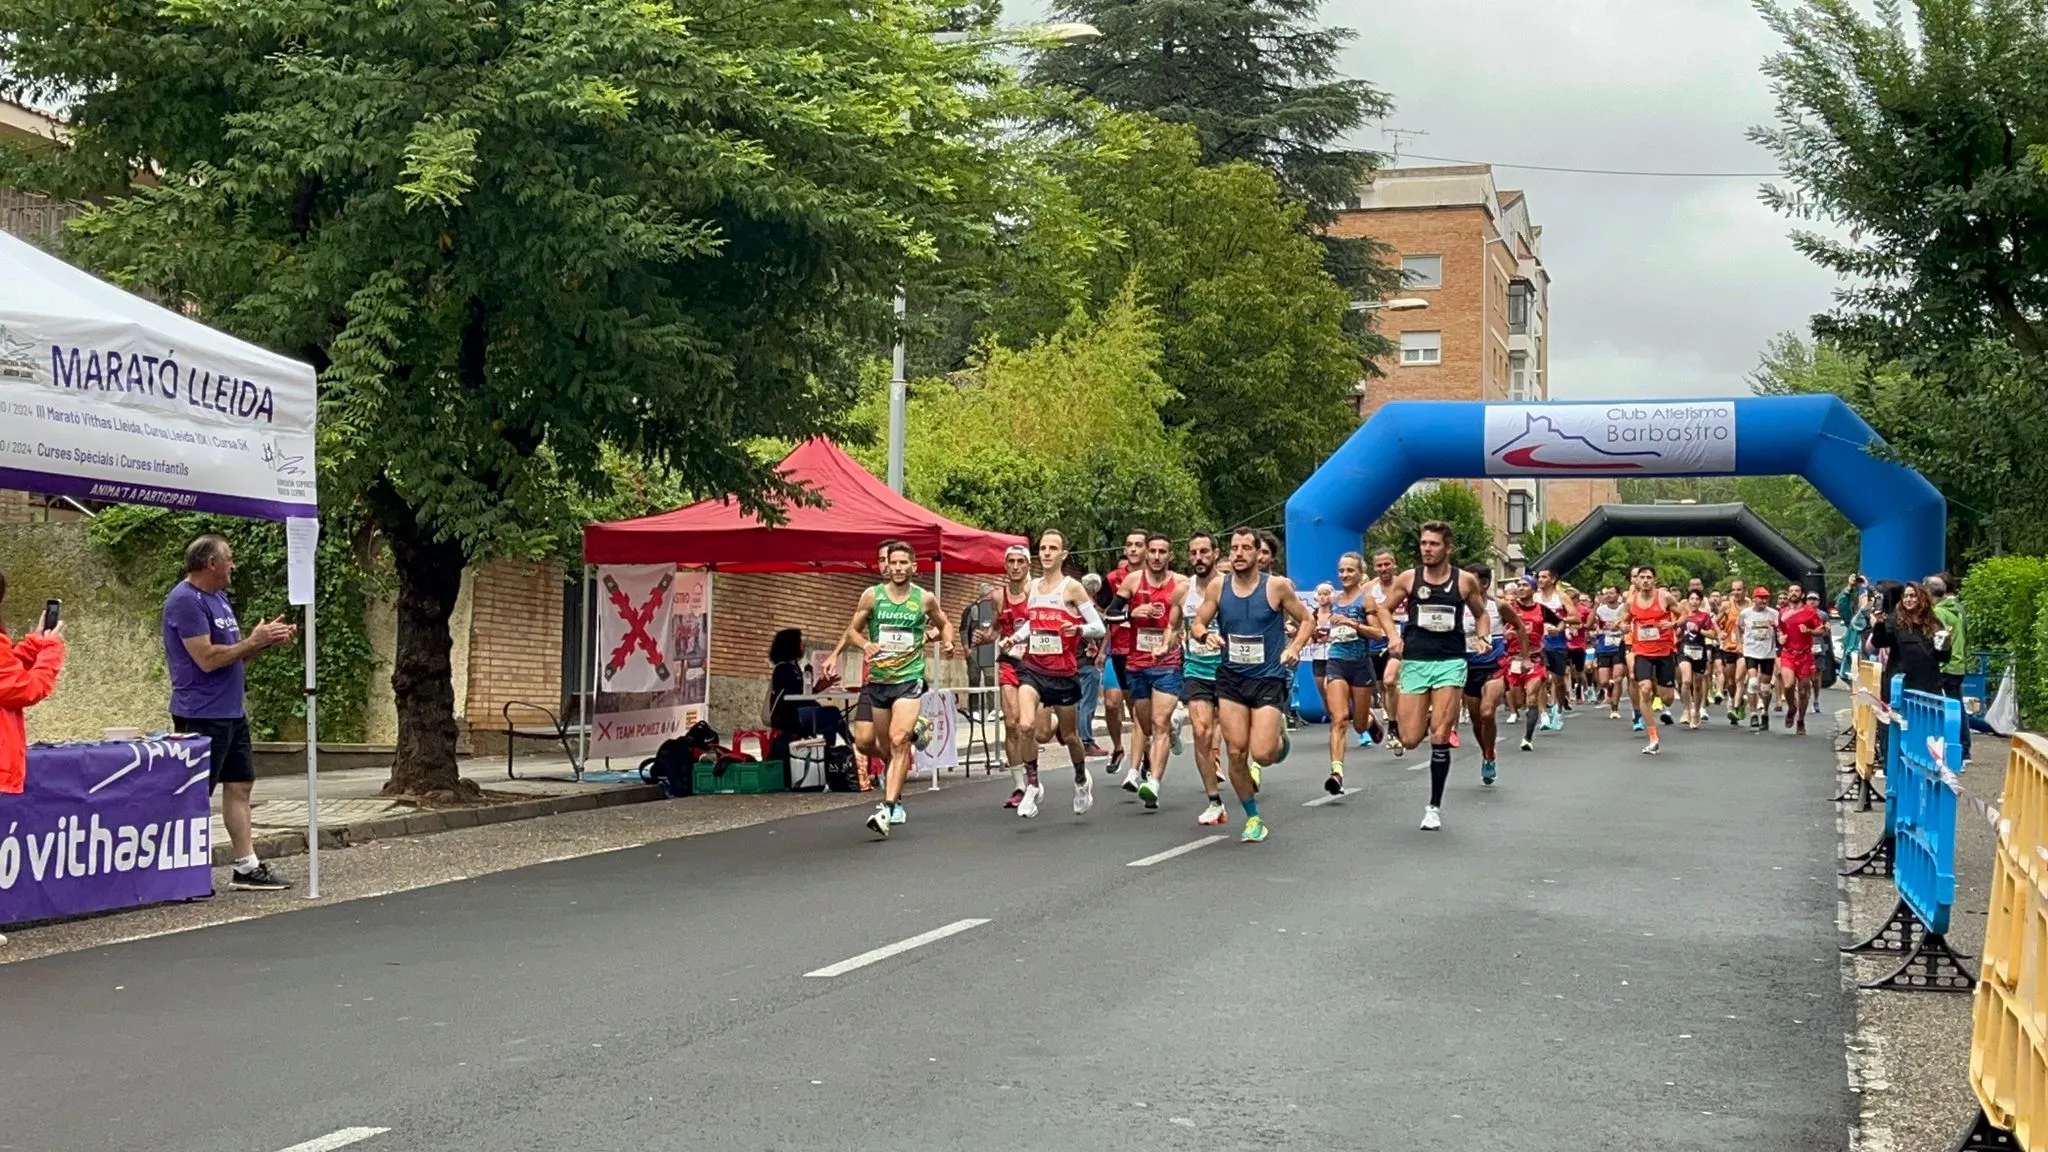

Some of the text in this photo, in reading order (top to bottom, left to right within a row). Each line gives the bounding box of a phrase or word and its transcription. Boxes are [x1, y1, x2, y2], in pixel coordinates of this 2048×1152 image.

[51, 345, 274, 424] MARATÓ LLEIDA
[13, 403, 33, 417] 2024
[36, 404, 46, 419] III
[47, 406, 81, 425] Marató
[81, 412, 113, 430] Vithas
[168, 427, 196, 444] Lleida
[1606, 407, 1729, 421] Club Atletismo
[1606, 424, 1729, 443] Barbastro
[12, 441, 32, 455] 2024
[37, 442, 73, 460] Curses
[120, 454, 152, 472] Curses
[153, 458, 190, 477] Infantils
[89, 483, 199, 507] ANIMA'T A PARTICIPAR!!
[877, 610, 917, 622] Huesca
[1239, 645, 1251, 653] 32
[616, 724, 636, 740] TEAM
